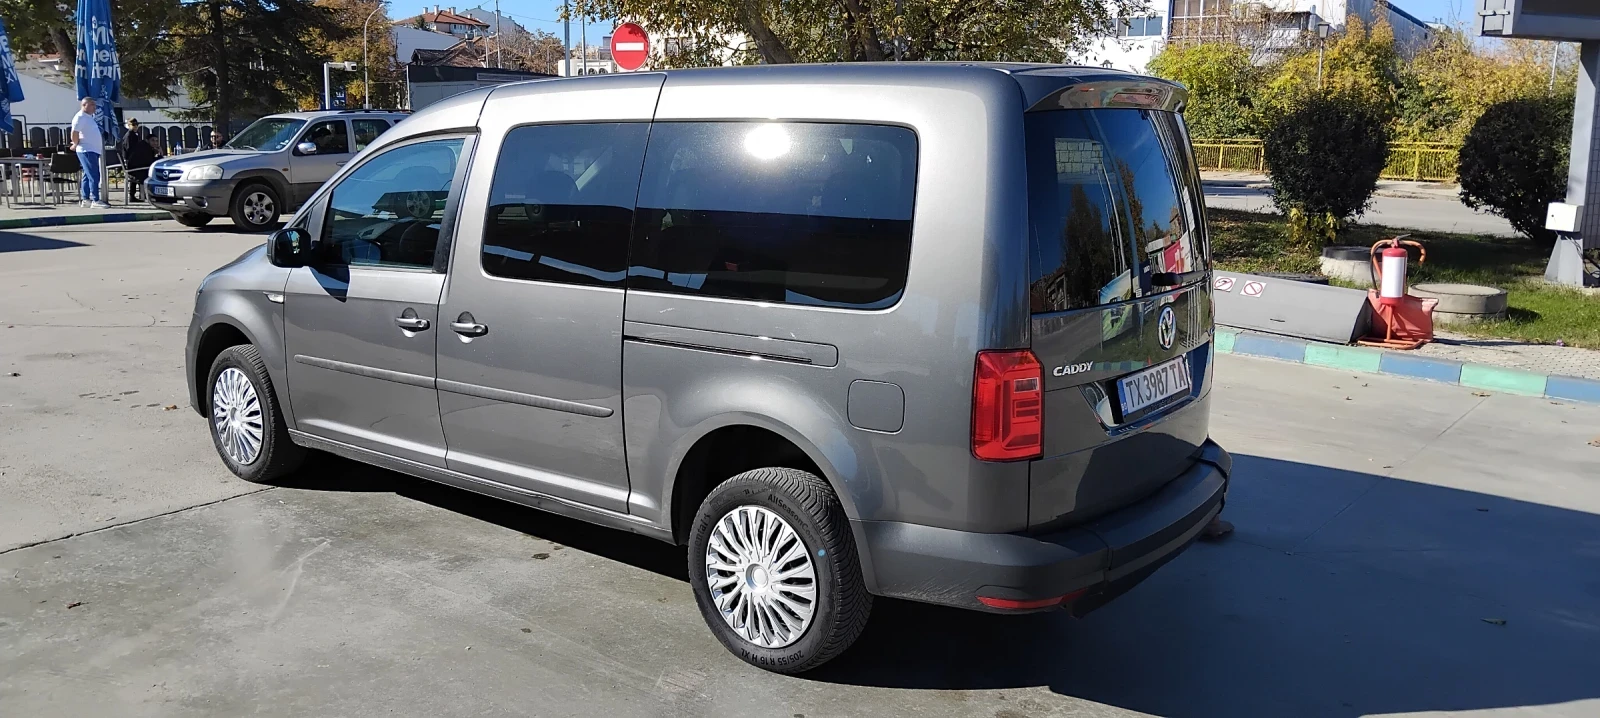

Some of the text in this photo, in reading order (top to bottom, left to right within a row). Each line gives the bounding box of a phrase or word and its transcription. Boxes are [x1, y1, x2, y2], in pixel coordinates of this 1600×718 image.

[1052, 361, 1094, 377] CADDY
[1125, 377, 1145, 408] TX
[1143, 367, 1169, 401] 3987
[1169, 362, 1186, 390] TA
[767, 493, 818, 546] AllSeasonCont
[740, 647, 805, 666] 205/55 R 16 H XL
